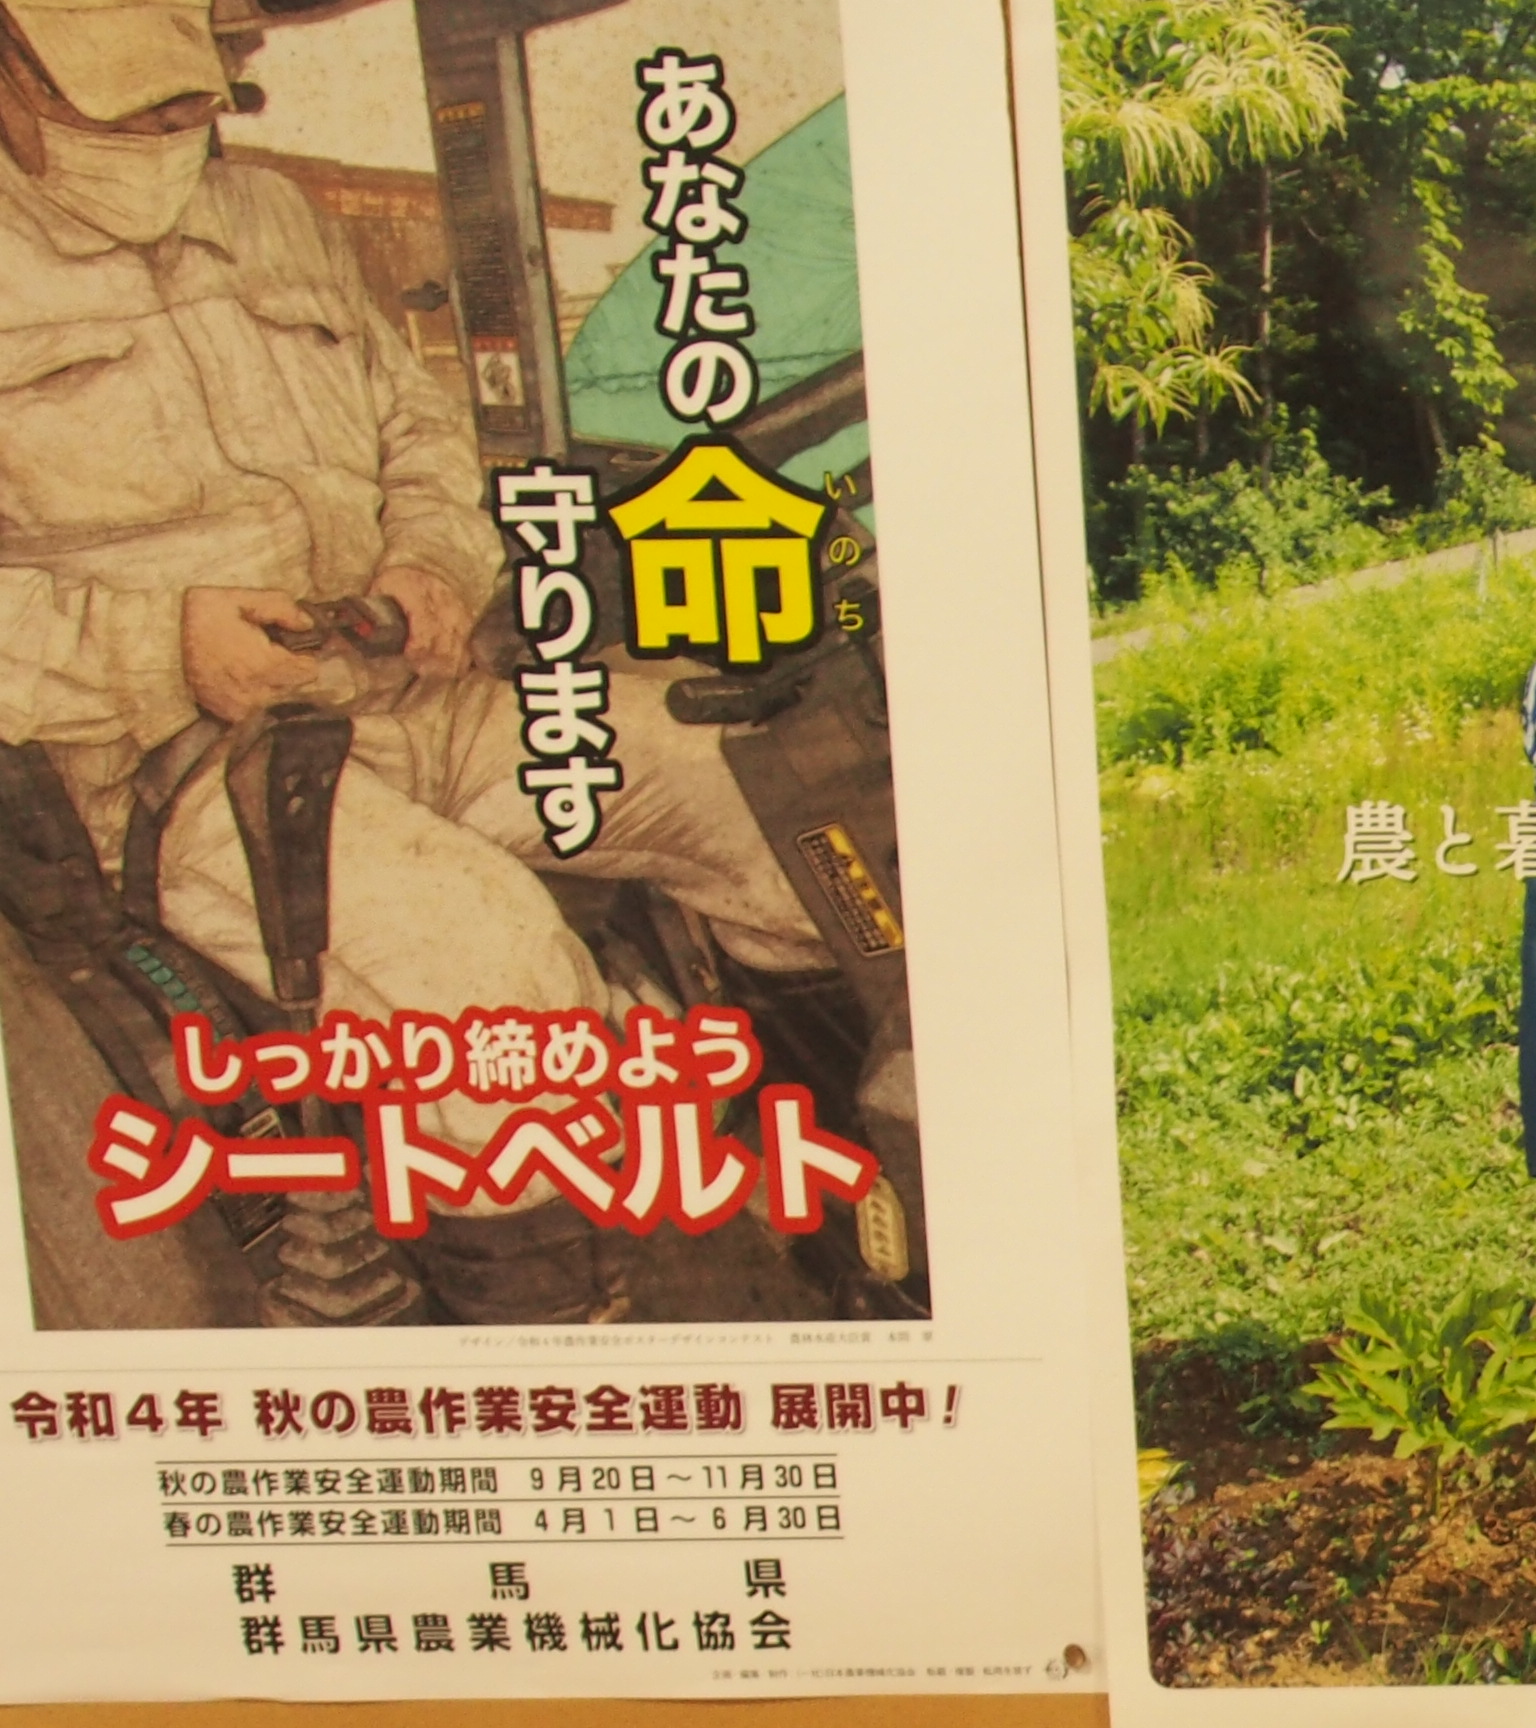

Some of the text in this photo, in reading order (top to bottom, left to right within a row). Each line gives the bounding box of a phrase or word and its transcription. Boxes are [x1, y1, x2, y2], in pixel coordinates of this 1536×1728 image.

[498, 466, 624, 856] 守ります
[180, 1013, 760, 1099] しっかり締めよう
[92, 1090, 873, 1234] シートベルト
[10, 1390, 226, 1439] 令和4年
[254, 1384, 743, 1435] 秋の農作業安全運動
[157, 1462, 500, 1497] 秋の農作業安全運動期間
[162, 1504, 503, 1539] 春の農作業安全運動期間
[240, 1608, 793, 1656] 群馬県農業機械化協会
